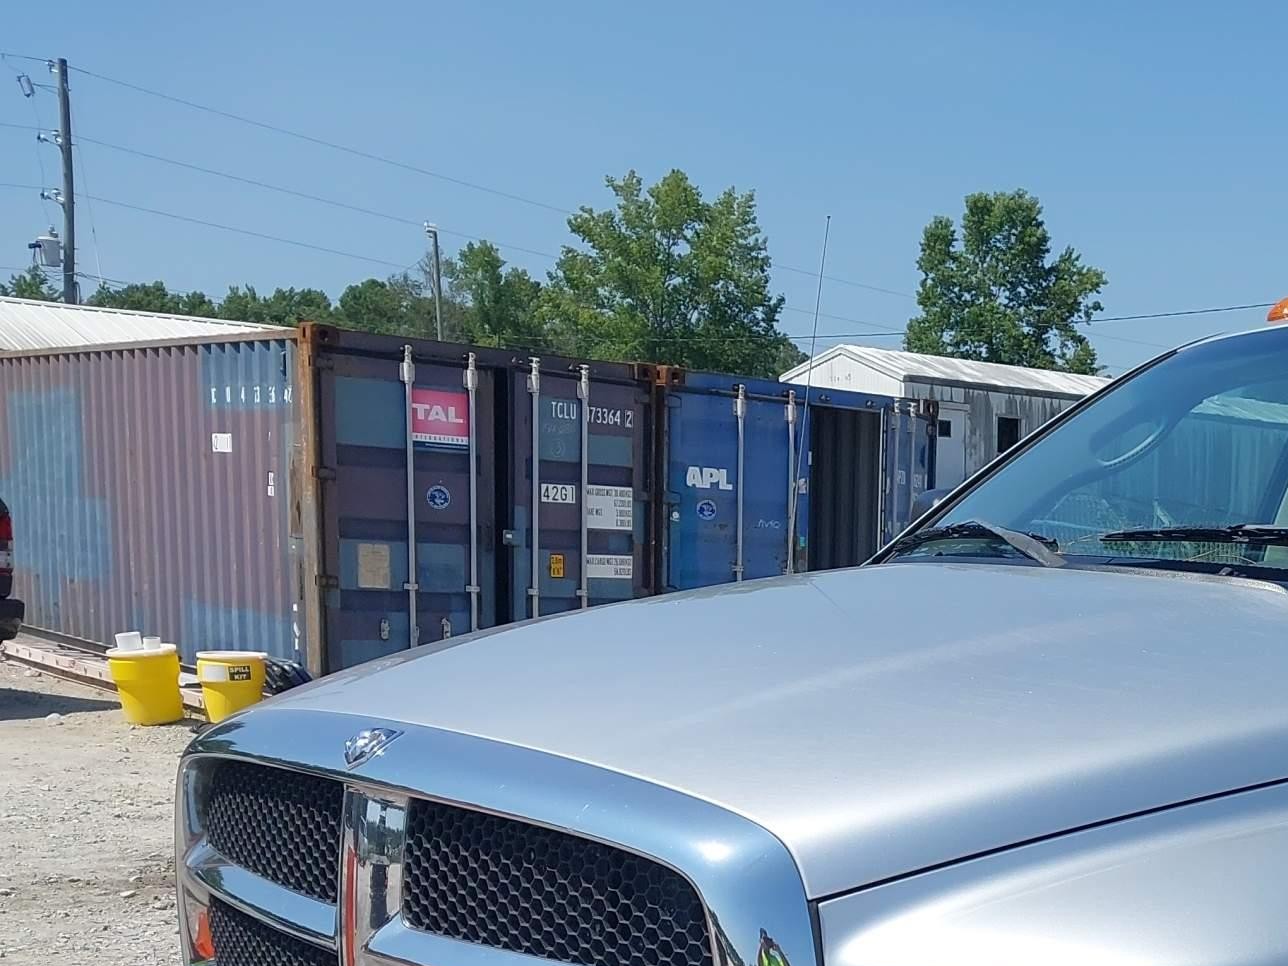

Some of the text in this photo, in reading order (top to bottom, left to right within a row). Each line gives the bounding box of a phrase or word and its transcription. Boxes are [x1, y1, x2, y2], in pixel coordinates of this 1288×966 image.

[412, 403, 464, 424] TAL
[551, 401, 577, 420] TCLU
[686, 466, 733, 490] APL
[543, 485, 575, 502] 42G1
